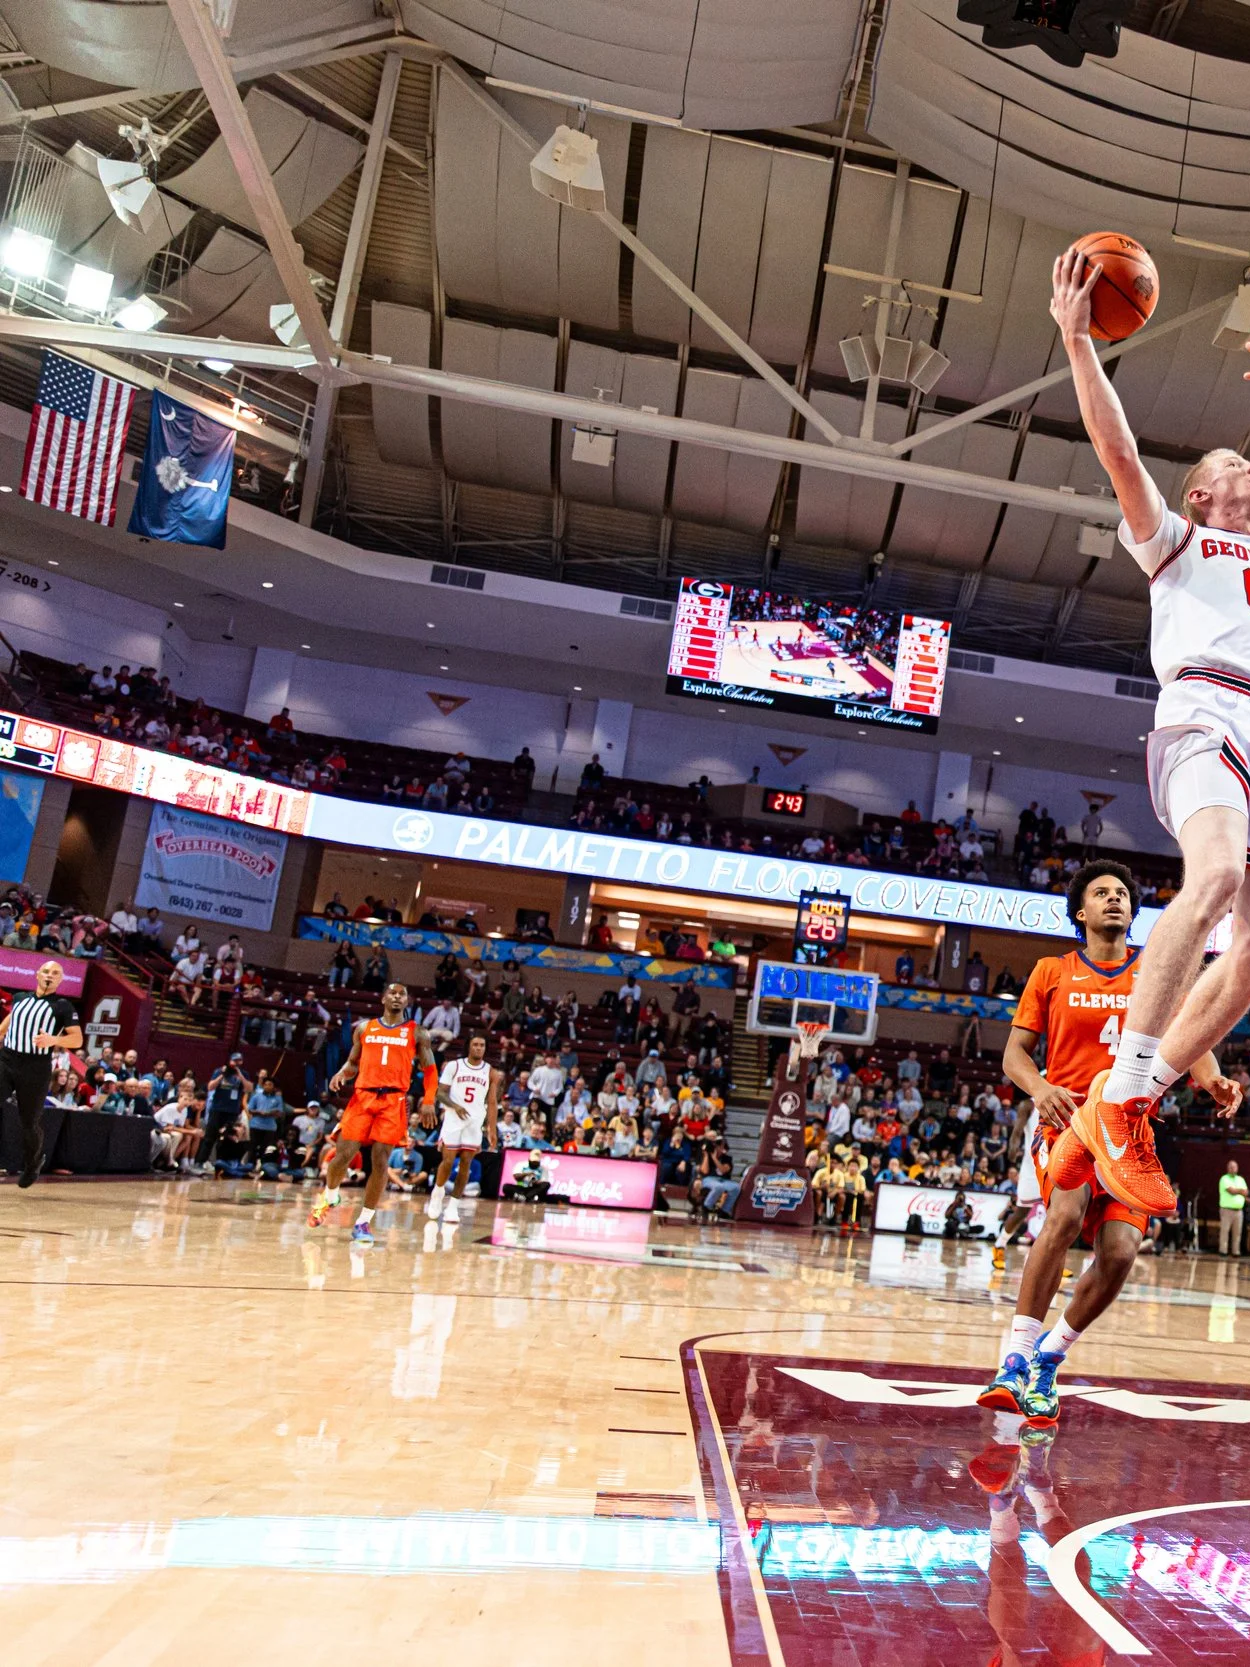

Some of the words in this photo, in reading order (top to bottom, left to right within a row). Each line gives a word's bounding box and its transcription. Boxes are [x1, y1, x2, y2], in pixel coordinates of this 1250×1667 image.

[675, 625, 691, 634] AST
[167, 839, 233, 857] OVERHEAD
[235, 852, 266, 874] DOOR
[455, 820, 689, 883] PALMETTO
[709, 854, 841, 896] FLOOR
[856, 874, 1062, 930] COVERINGS
[806, 915, 836, 940] 26
[1068, 992, 1131, 1009] CLEMS
[365, 1035, 408, 1046] CLEMSON
[1099, 1015, 1121, 1056] 4
[381, 1046, 388, 1066] 1
[457, 1076, 487, 1087] GEORGIA
[464, 1087, 476, 1103] 5
